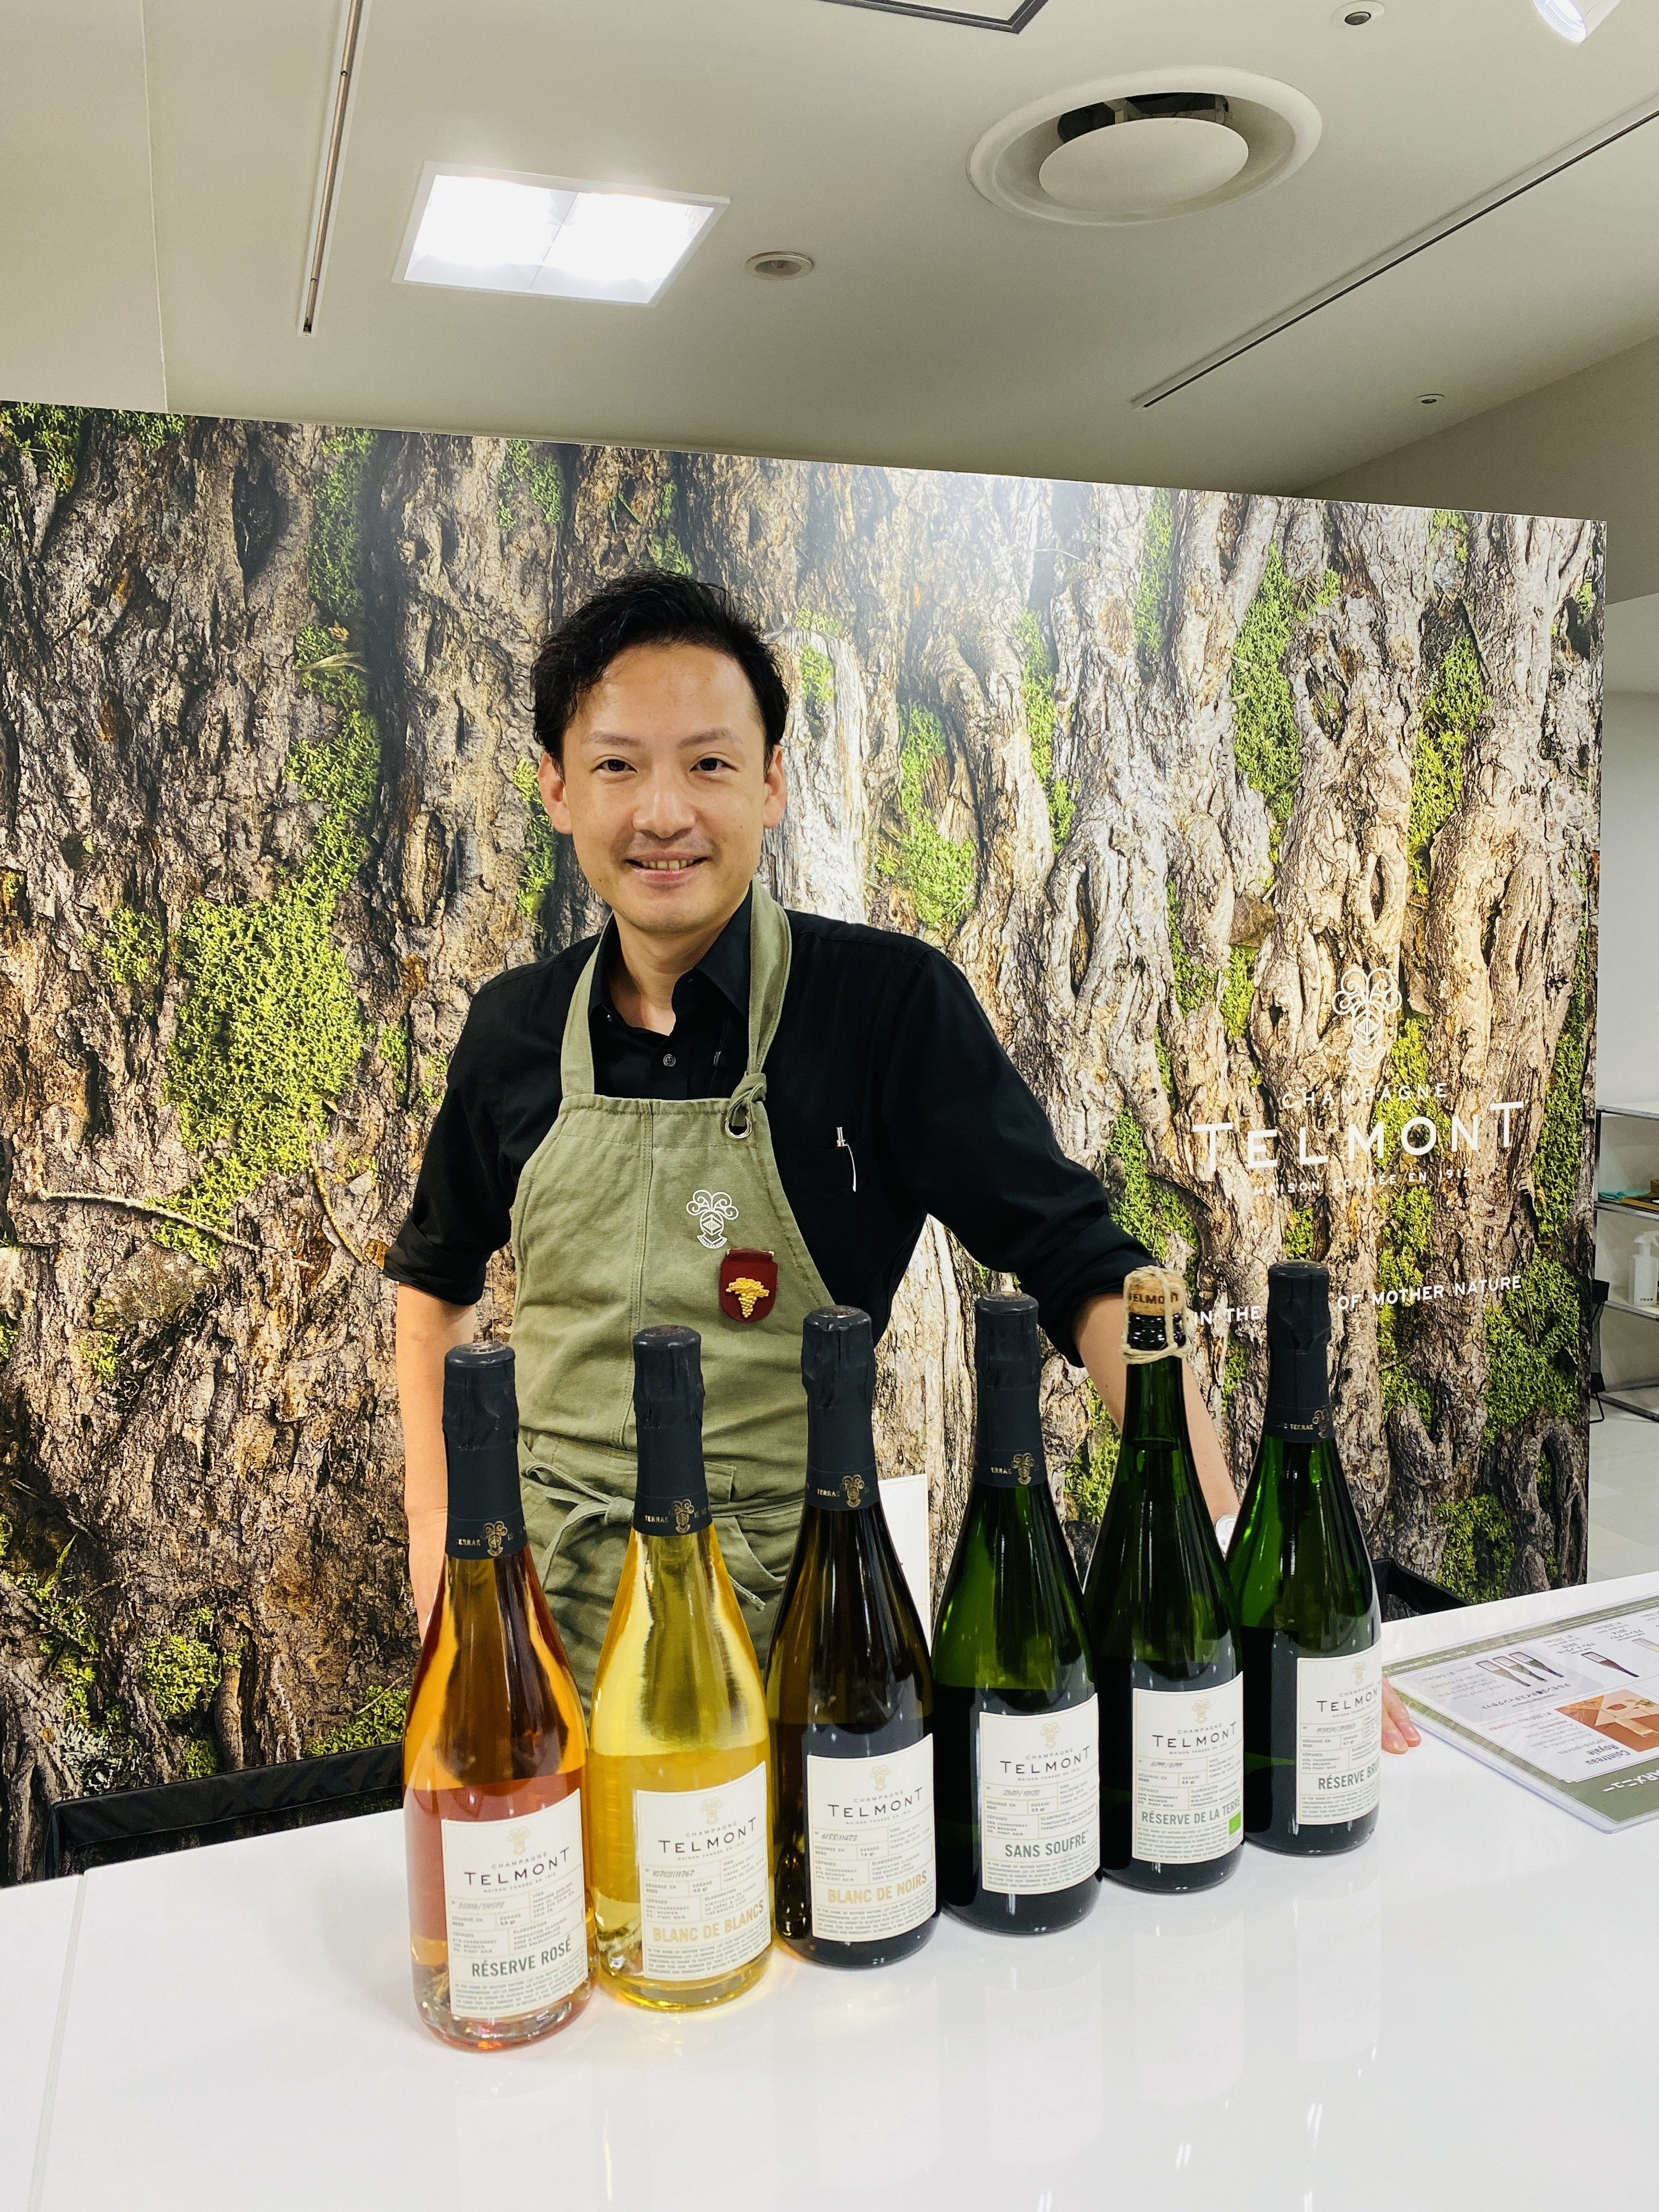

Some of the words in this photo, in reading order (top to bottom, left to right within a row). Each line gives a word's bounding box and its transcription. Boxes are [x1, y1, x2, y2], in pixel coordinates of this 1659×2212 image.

[1282, 1083, 1447, 1109] CHAMPAGNE
[1192, 1102, 1523, 1172] TELMONT
[1255, 1182, 1319, 1195] MAISON
[1333, 1173, 1397, 1189] FONDÉE
[1409, 1172, 1426, 1182] EN
[1440, 1168, 1470, 1180] 1912
[1194, 1310, 1212, 1325] IN
[1225, 1306, 1261, 1323] THE
[1337, 1293, 1361, 1311] OF
[1372, 1285, 1444, 1306] MOTHER
[1455, 1276, 1522, 1296] NATURE
[1152, 1722, 1237, 1747] TELMONT
[1177, 1723, 1222, 1734] CHAMPAGNE
[1000, 1746, 1090, 1774] TELMONT
[1026, 1747, 1074, 1760] CHAMPAGNE
[1585, 1750, 1630, 1765] Cointreau
[1587, 1744, 1620, 1757] Royale
[1318, 1769, 1364, 1790] RÉSERVE
[827, 1787, 922, 1818] TELMONT
[854, 1790, 904, 1803] CHAMPAGNE
[1142, 1810, 1190, 1825] RÉSERVE
[1194, 1812, 1206, 1824] DE
[1210, 1808, 1220, 1820] LA
[1222, 1795, 1240, 1816] TERRE
[658, 1816, 756, 1853] TELMONT
[685, 1821, 737, 1837] CHAMPAGNE
[492, 1852, 548, 1869] CHAMPAGNE
[1005, 1844, 1040, 1858] SANS
[464, 1847, 569, 1886] TELMONT
[828, 1888, 872, 1904] BLANC
[877, 1886, 892, 1901] DE
[897, 1870, 927, 1896] NOIRS
[652, 1927, 698, 1943] BLANC
[703, 1923, 720, 1939] DE
[724, 1899, 764, 1933] BLANCS
[472, 1955, 536, 1977] RÉSERVE
[541, 1934, 572, 1966] ROSÉ
